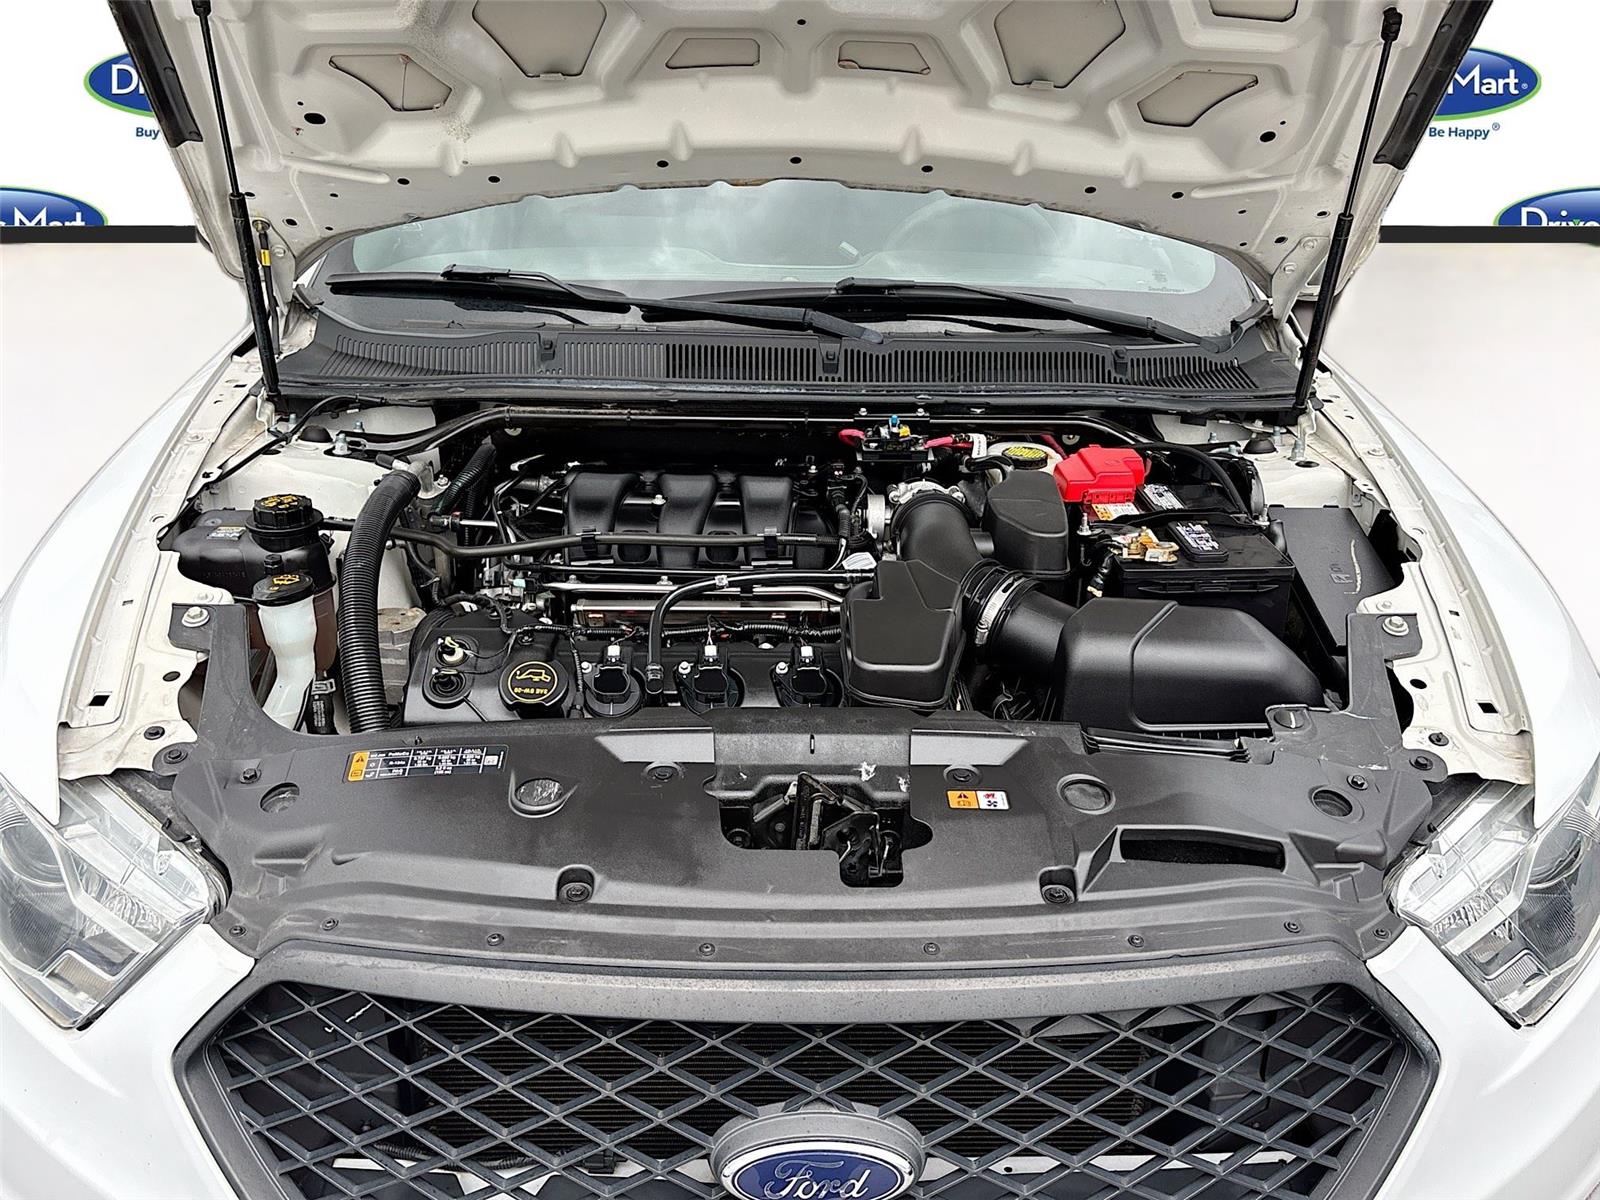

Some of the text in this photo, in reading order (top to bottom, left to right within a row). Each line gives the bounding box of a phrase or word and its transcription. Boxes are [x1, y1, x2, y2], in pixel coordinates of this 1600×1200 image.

[136, 127, 160, 140] Buy
[1428, 127, 1445, 138] Be
[1448, 127, 1490, 140] Happy
[764, 1159, 871, 1200] Ford
